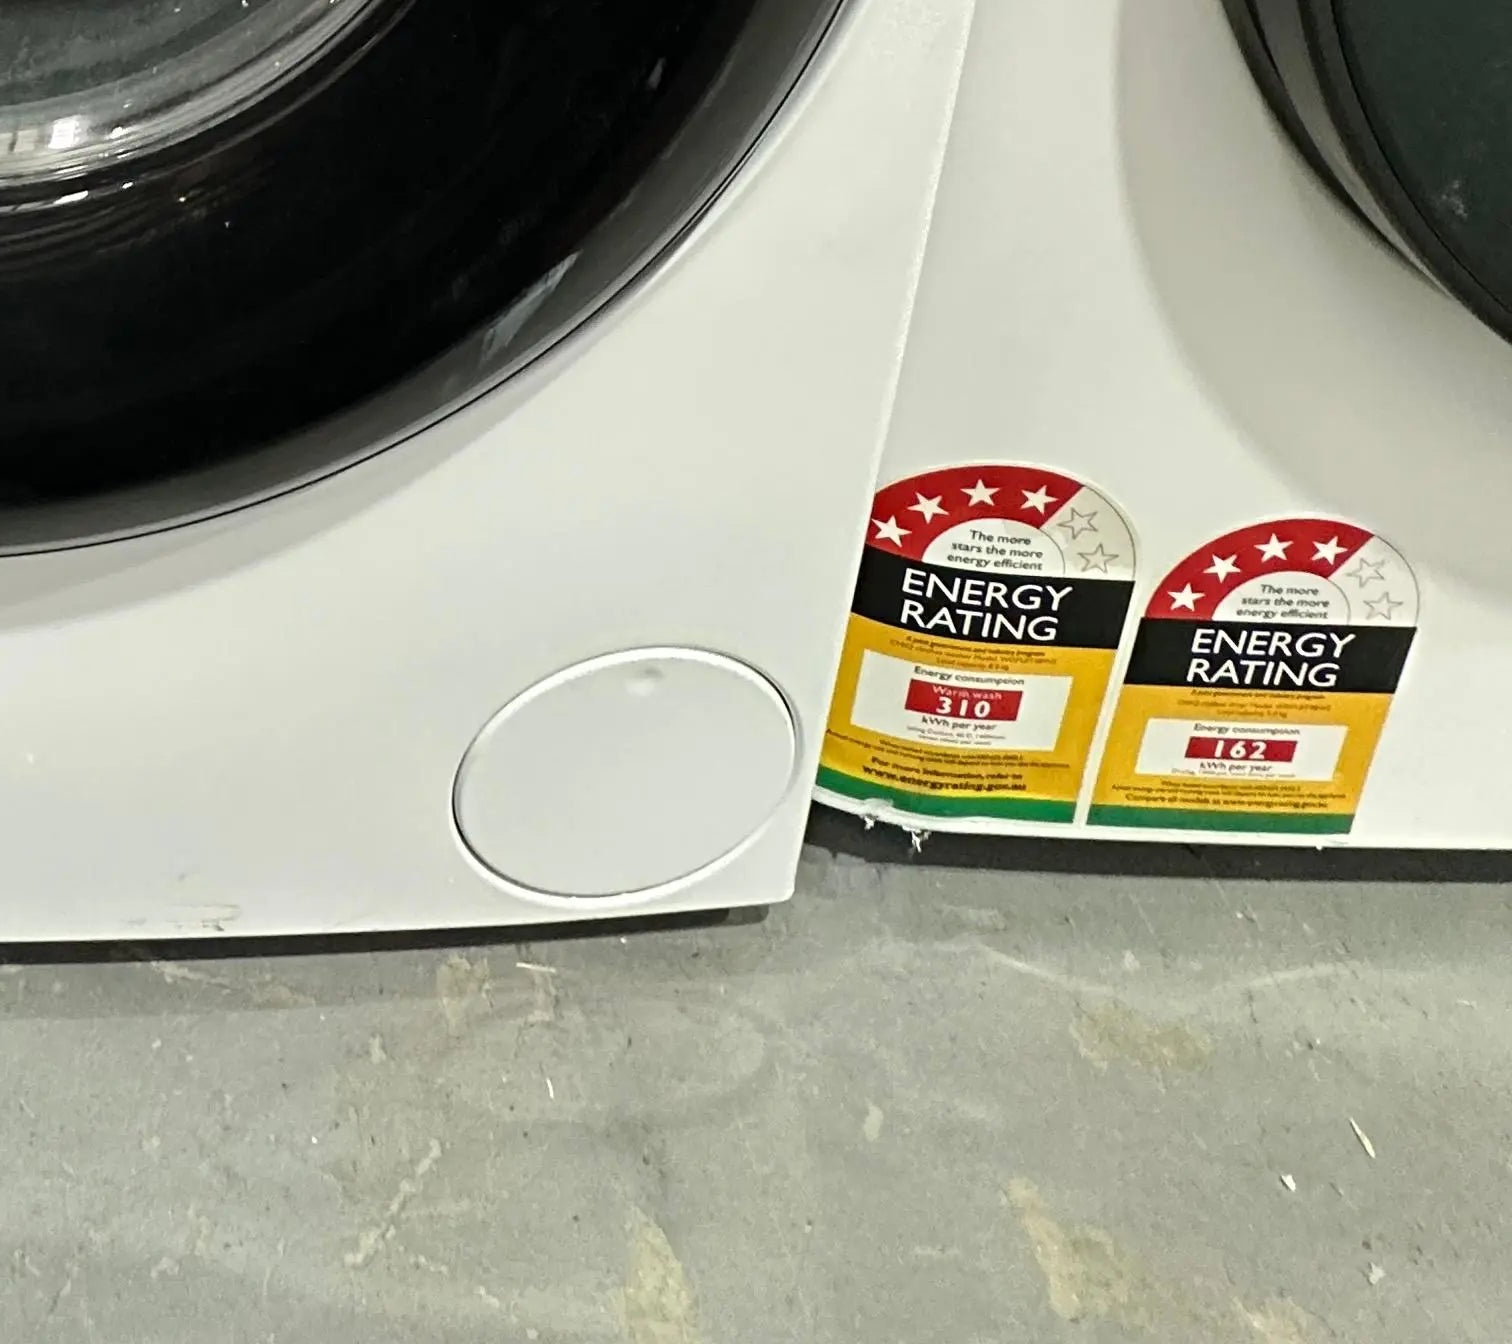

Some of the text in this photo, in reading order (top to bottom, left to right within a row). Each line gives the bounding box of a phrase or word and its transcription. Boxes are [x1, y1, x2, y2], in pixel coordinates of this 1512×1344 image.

[970, 529, 1031, 545] The more
[952, 542, 1043, 558] stars the more
[947, 554, 1042, 570] energy efficient
[902, 567, 1073, 612] ENERGY
[1260, 584, 1319, 595] The more
[1242, 596, 1330, 608] stars the more
[901, 599, 1058, 641] RATING
[1237, 609, 1328, 620] energy efficient
[1191, 628, 1356, 658] ENERGY
[914, 666, 952, 680] Energy
[1187, 658, 1340, 687] RATING
[932, 685, 1002, 700] Warm wash
[936, 697, 991, 718] 310
[921, 714, 997, 732] kWh per year
[1194, 723, 1230, 734] Energy
[1214, 740, 1267, 760] 162
[1200, 762, 1226, 770] kWh
[1229, 763, 1246, 772] per
[1250, 765, 1272, 773] year
